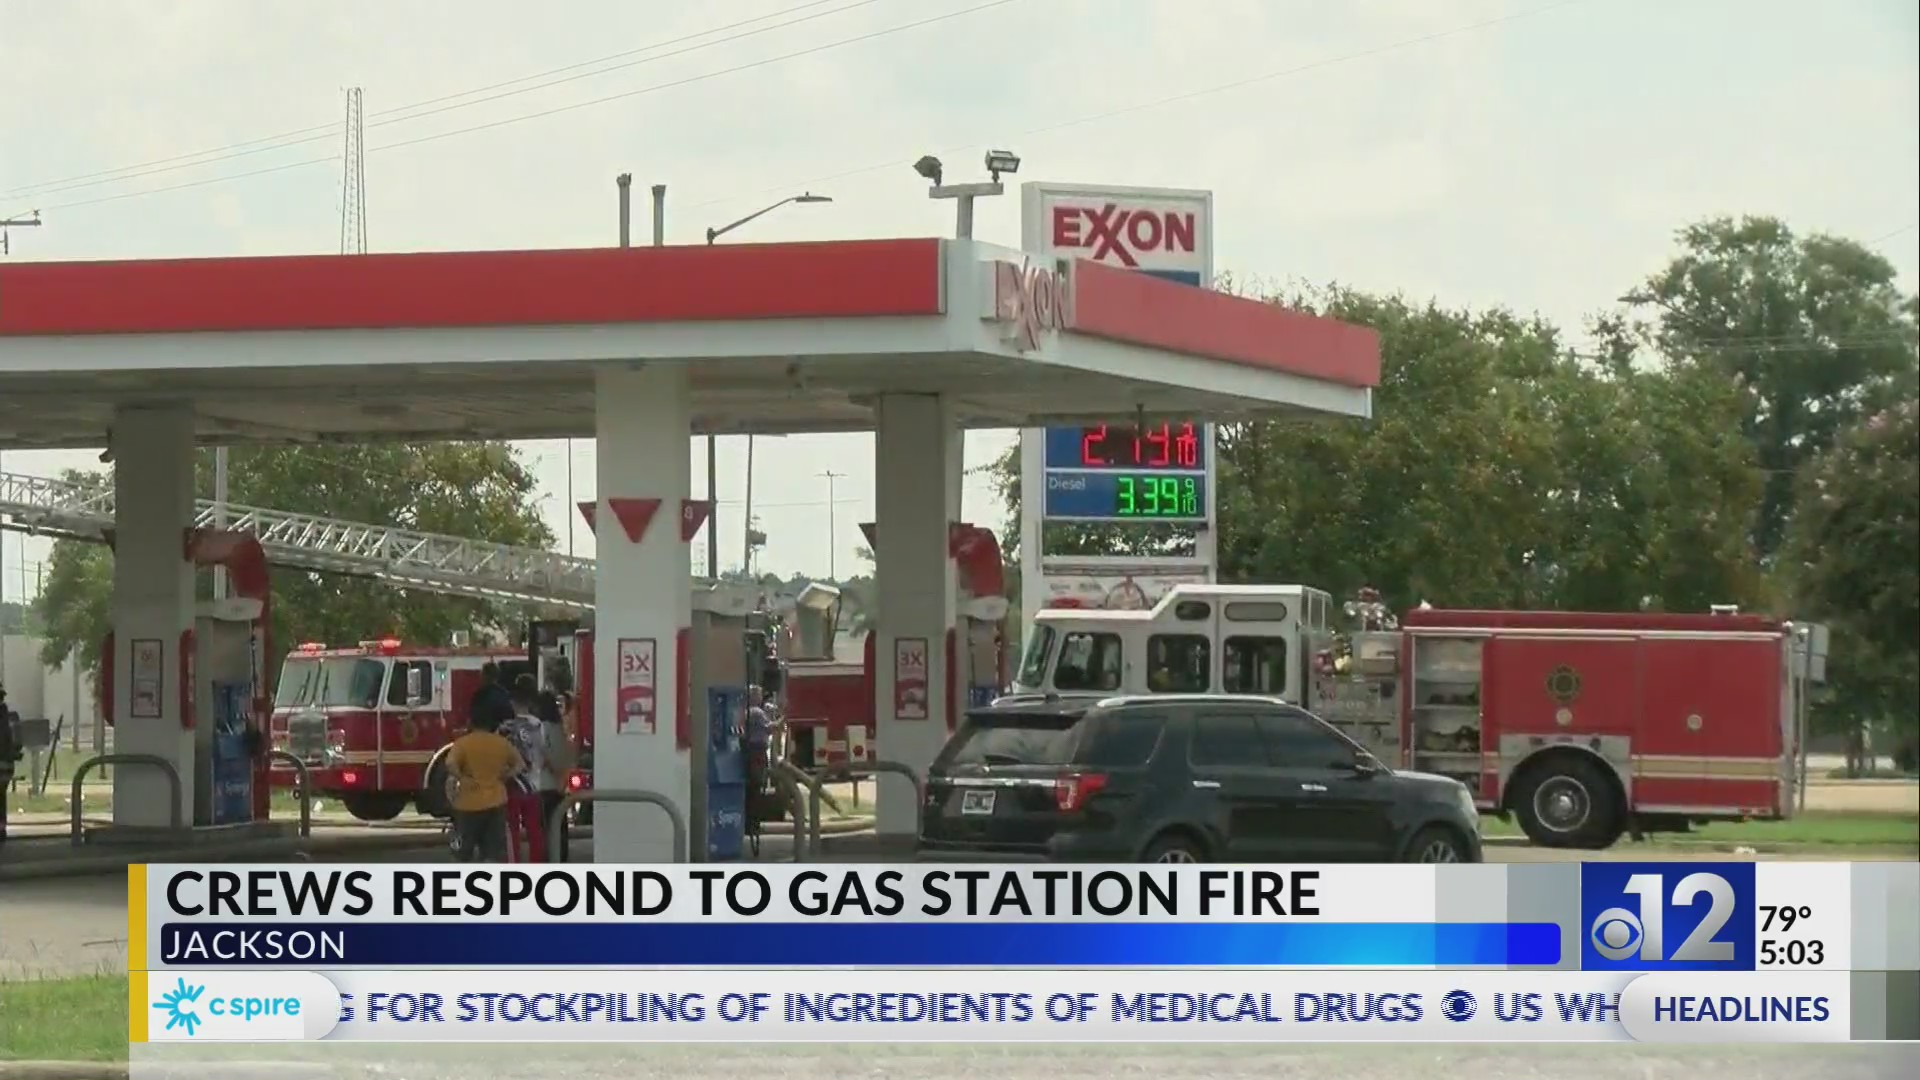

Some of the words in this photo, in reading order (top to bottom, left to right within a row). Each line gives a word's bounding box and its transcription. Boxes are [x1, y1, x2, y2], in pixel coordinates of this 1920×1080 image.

[1053, 203, 1195, 267] EXXON
[990, 256, 1069, 351] EXXON
[1049, 478, 1086, 491] Diesel
[1118, 477, 1179, 514] 3.39
[624, 654, 650, 672] 3X
